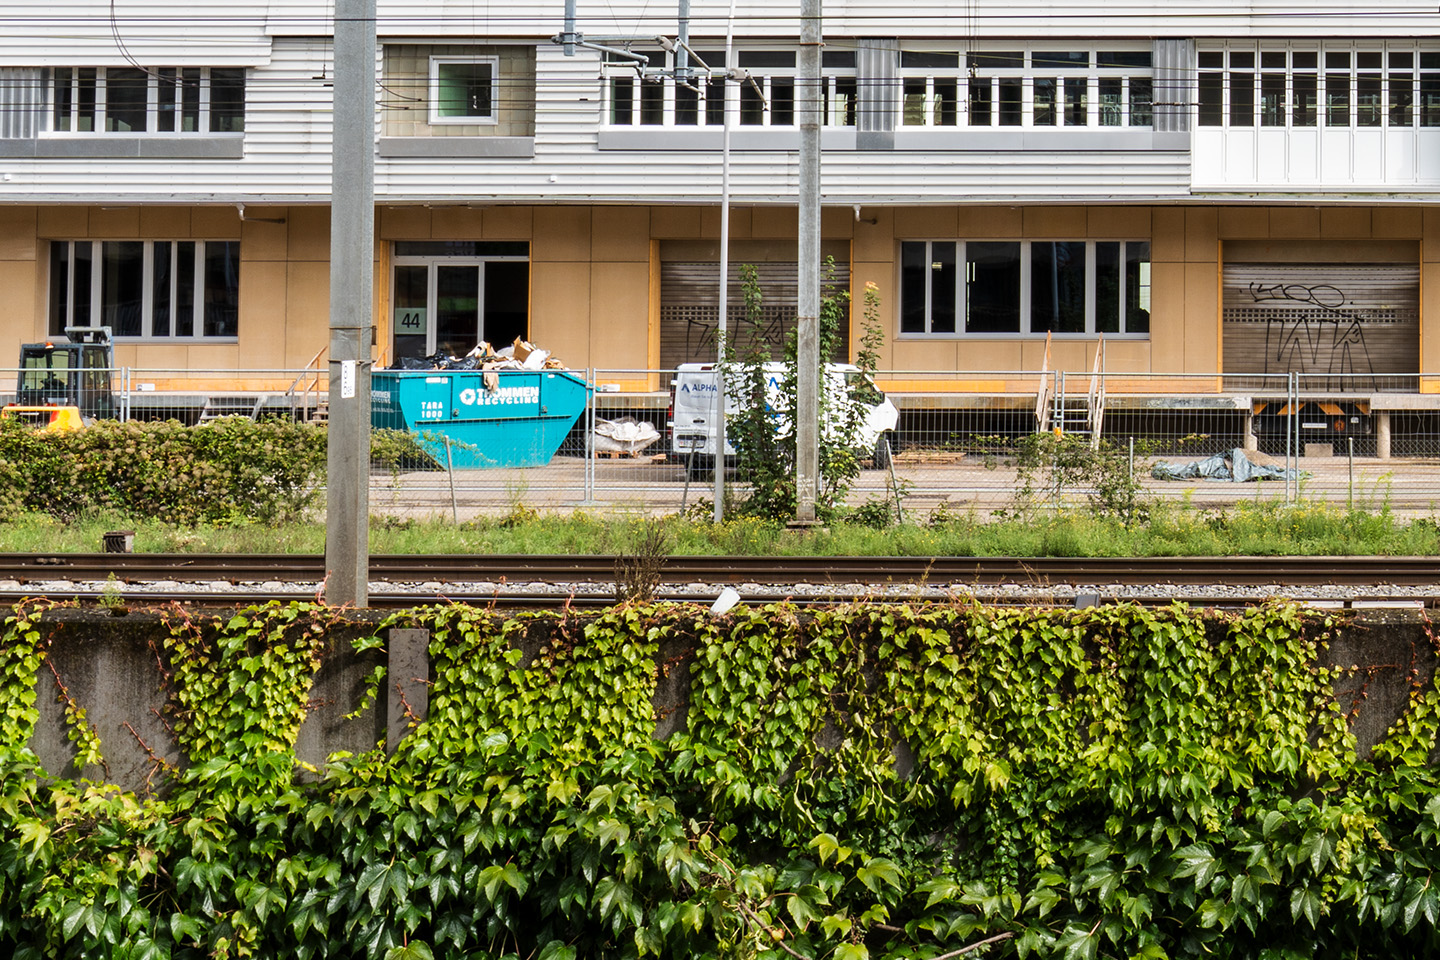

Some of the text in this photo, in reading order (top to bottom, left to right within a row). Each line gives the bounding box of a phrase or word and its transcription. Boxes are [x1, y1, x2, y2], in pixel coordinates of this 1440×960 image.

[401, 313, 420, 328] 44
[692, 384, 717, 392] ALPHA
[421, 401, 443, 410] TARA
[476, 396, 539, 406] RECYCLING
[421, 410, 442, 418] 1000
